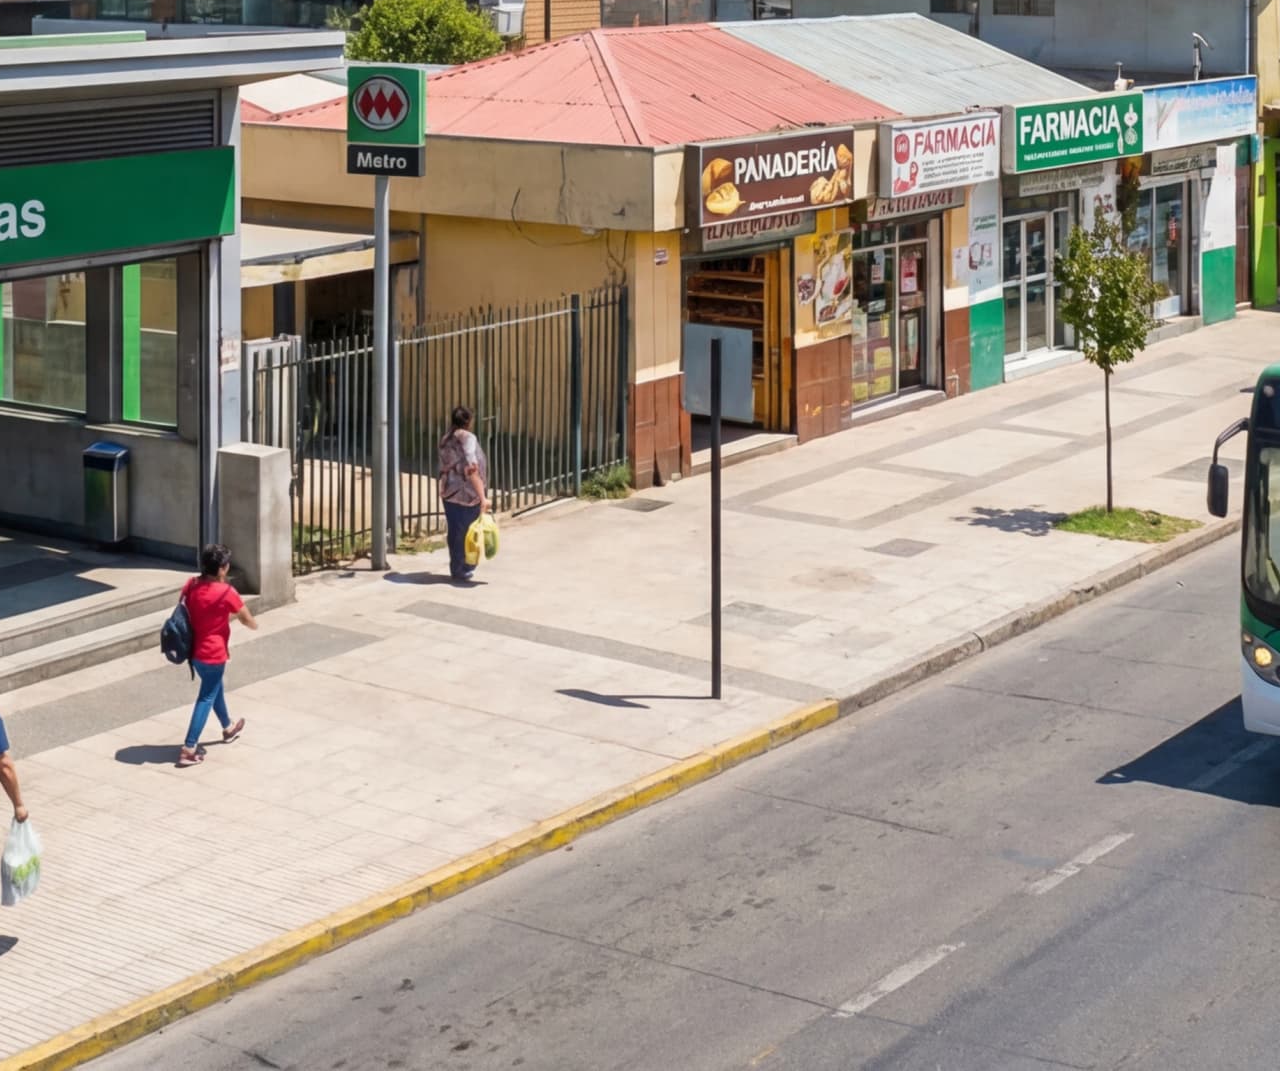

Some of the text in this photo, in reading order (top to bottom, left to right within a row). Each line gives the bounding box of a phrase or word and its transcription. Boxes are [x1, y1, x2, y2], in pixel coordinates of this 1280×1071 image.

[914, 119, 996, 157] FARMACIA
[1020, 104, 1120, 146] FARMACIA
[357, 152, 407, 169] Metro
[734, 141, 838, 185] PANADERÍA
